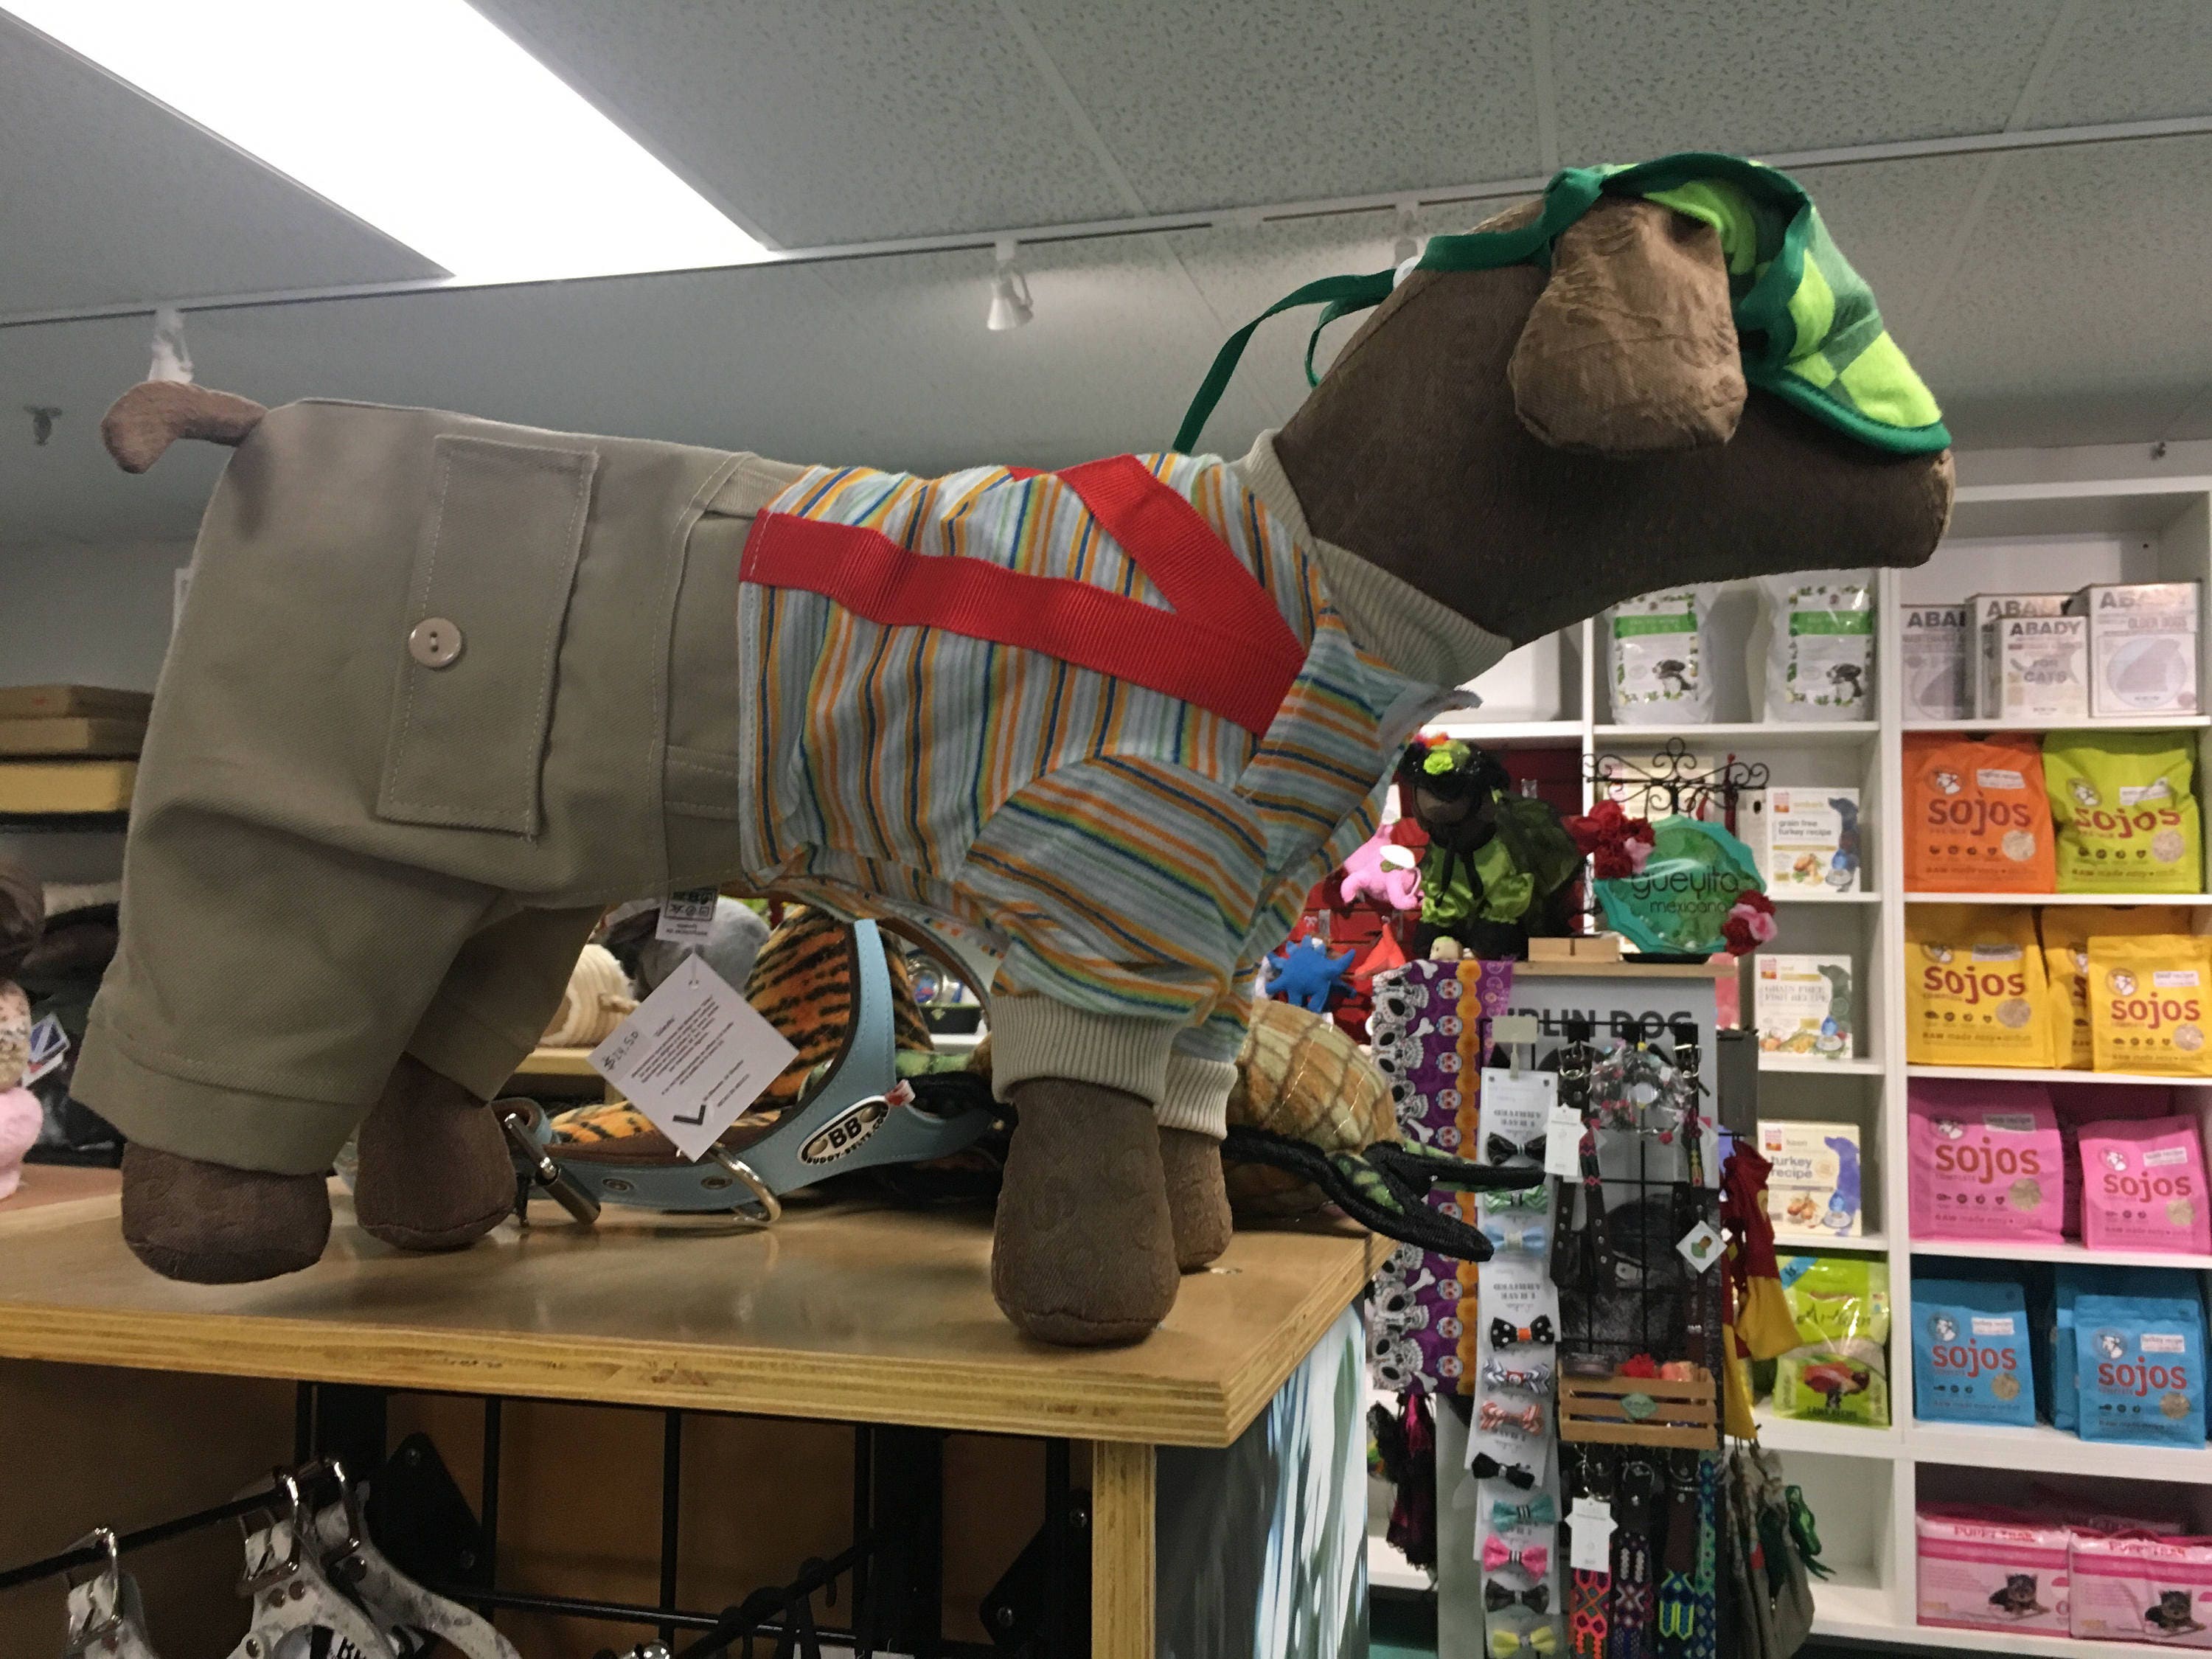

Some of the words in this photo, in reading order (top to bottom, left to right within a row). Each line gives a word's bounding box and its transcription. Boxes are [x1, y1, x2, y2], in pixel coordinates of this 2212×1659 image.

[2009, 621, 2081, 636] ABADY
[1928, 790, 2031, 836] sojos
[2074, 808, 2180, 838] sojos
[1924, 966, 2026, 1004] sojos
[2111, 992, 2201, 1029] sojos
[828, 1116, 862, 1149] BB
[1770, 1155, 1812, 1168] turkey
[1770, 1168, 1813, 1180] recipe
[1935, 1136, 2040, 1184] sojos
[2104, 1171, 2192, 1203] sojos
[1932, 1338, 2017, 1378] sojos
[2098, 1356, 2187, 1397] sojos
